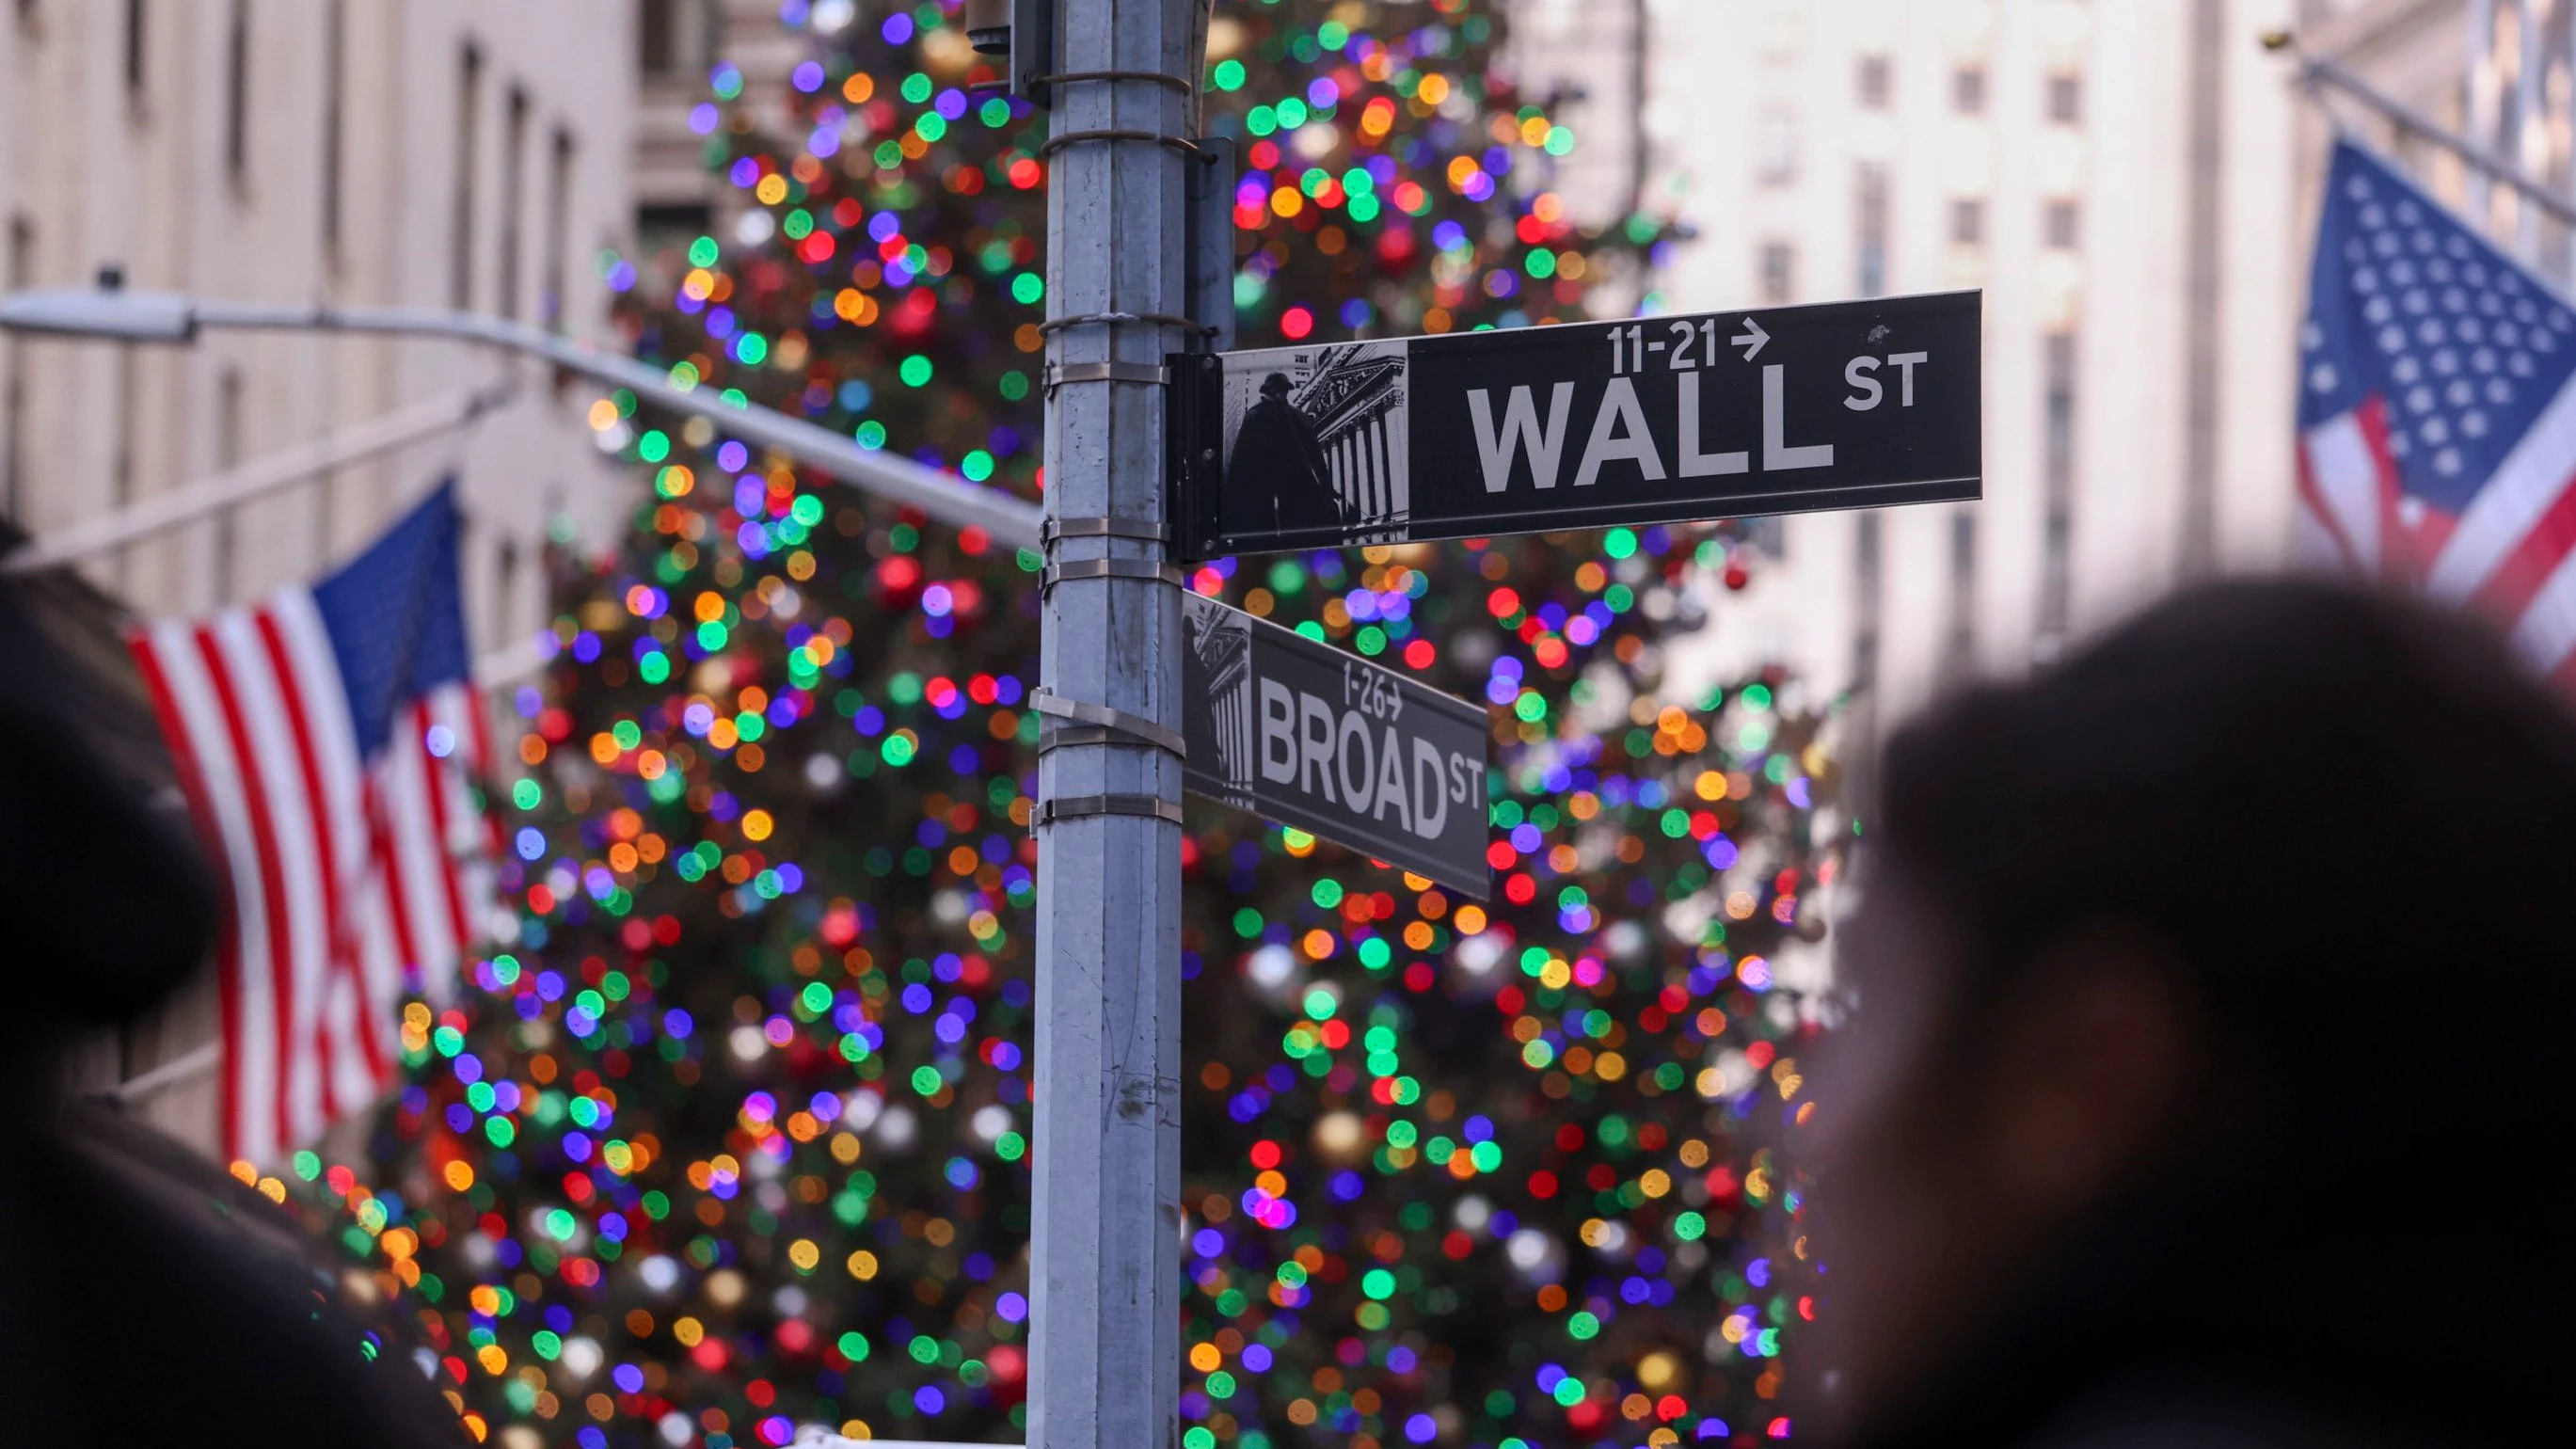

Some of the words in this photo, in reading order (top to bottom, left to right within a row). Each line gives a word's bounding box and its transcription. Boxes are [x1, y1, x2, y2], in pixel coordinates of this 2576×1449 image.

[1608, 318, 1717, 374] 11-21
[1467, 363, 1834, 493] WALL
[1844, 351, 1928, 410] ST
[1344, 662, 1386, 719] 1-26
[1261, 677, 1447, 839] BROAD
[1450, 752, 1483, 809] ST
